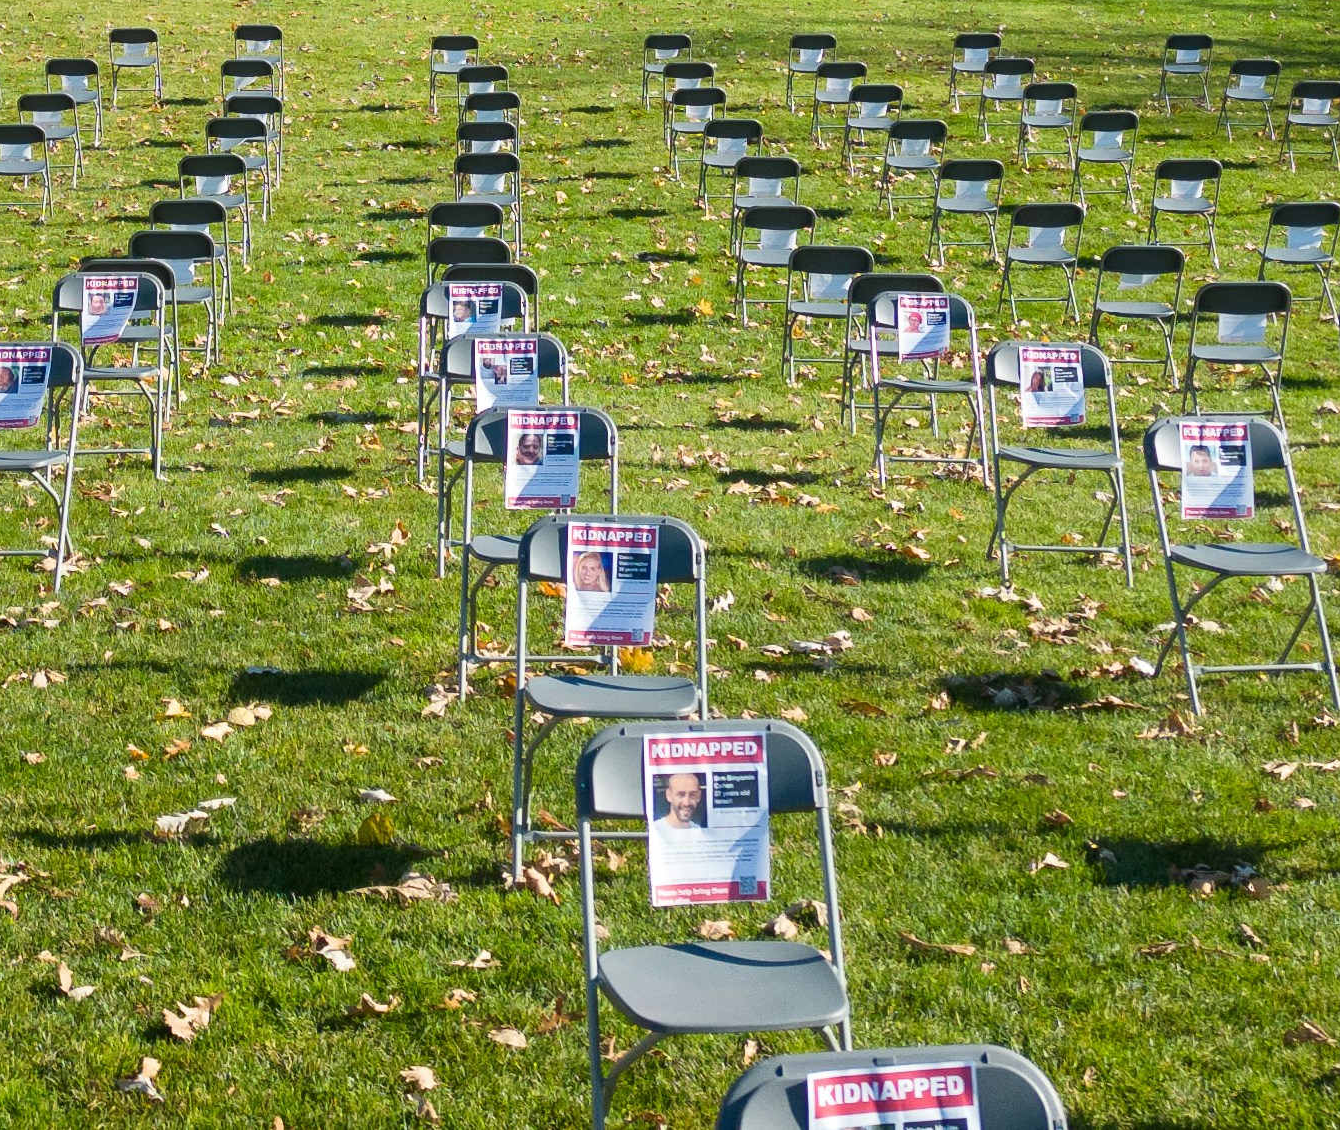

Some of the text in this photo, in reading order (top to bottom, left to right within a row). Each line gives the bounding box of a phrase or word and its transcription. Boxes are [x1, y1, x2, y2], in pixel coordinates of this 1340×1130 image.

[86, 279, 135, 287] KIDNAPPED
[480, 342, 533, 351] KIDNAPPED
[1024, 350, 1077, 360] KIDNAPPED
[511, 415, 575, 426] KIDNAPPED
[1183, 427, 1245, 437] KIDNAPPED
[573, 529, 652, 542] KIDNAPPED
[652, 741, 758, 759] KIDNAPPED
[817, 1075, 965, 1107] KIDNAPPED
